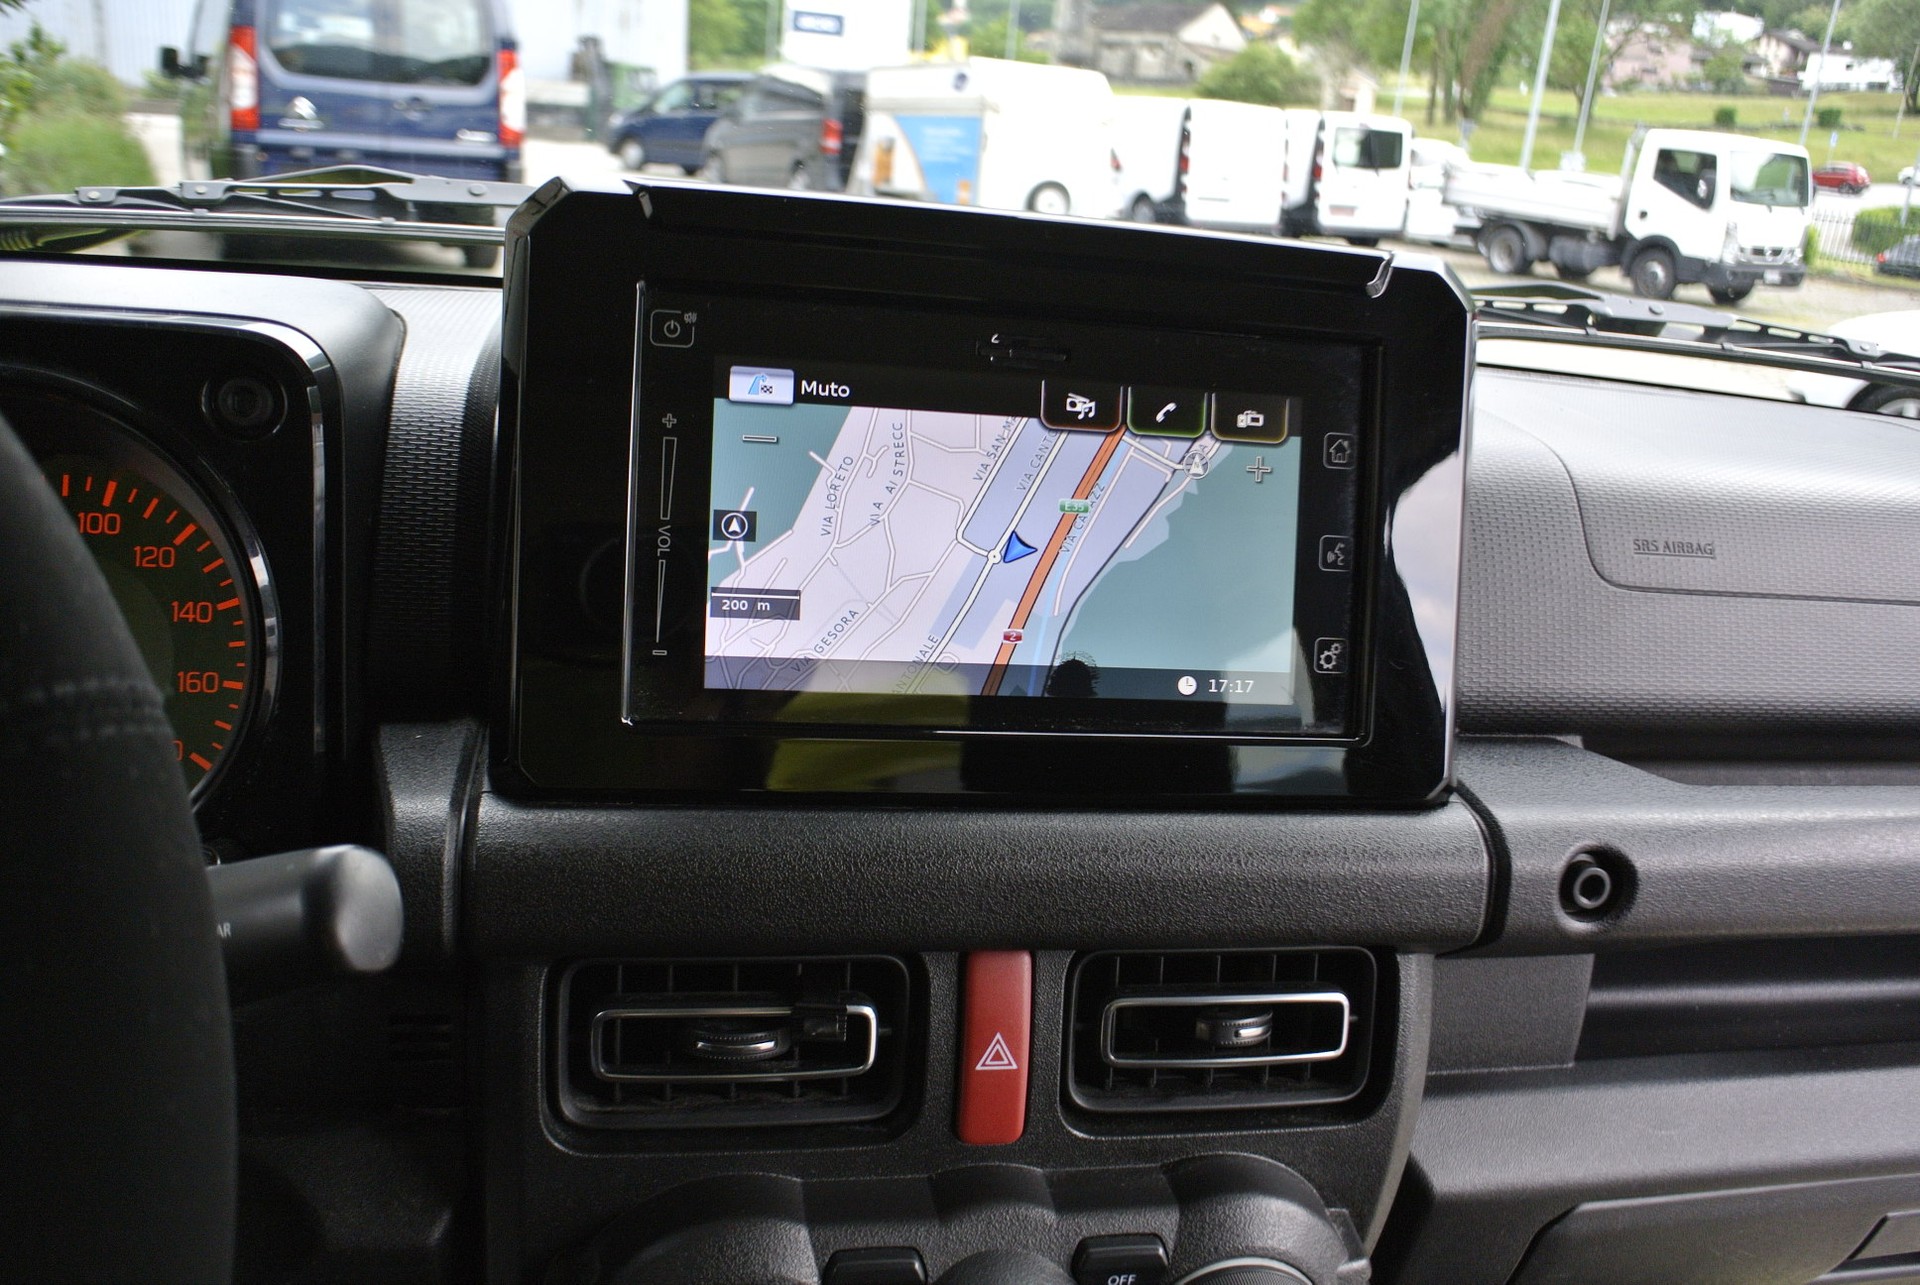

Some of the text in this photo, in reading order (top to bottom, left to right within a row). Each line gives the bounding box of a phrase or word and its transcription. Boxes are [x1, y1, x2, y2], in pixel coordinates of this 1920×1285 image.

[801, 380, 850, 398] Muto
[973, 462, 991, 480] VIA
[987, 435, 1006, 459] SAN
[1016, 473, 1034, 491] VIA
[821, 456, 854, 536] VIA LORETO
[869, 502, 883, 526] VIA
[1064, 502, 1085, 512] E35
[78, 512, 121, 535] 100
[657, 525, 671, 556] VOL
[1060, 536, 1077, 552] VIA
[1633, 539, 1714, 555] SRS AIRBAG
[134, 546, 176, 568] 120
[171, 600, 213, 623] 140
[721, 600, 770, 611] 200 m
[790, 609, 859, 672] VIA GESORA
[1009, 632, 1016, 641] 2
[176, 671, 219, 693] 160
[1208, 679, 1254, 693] 17:17
[1108, 1274, 1137, 1285] OFF
